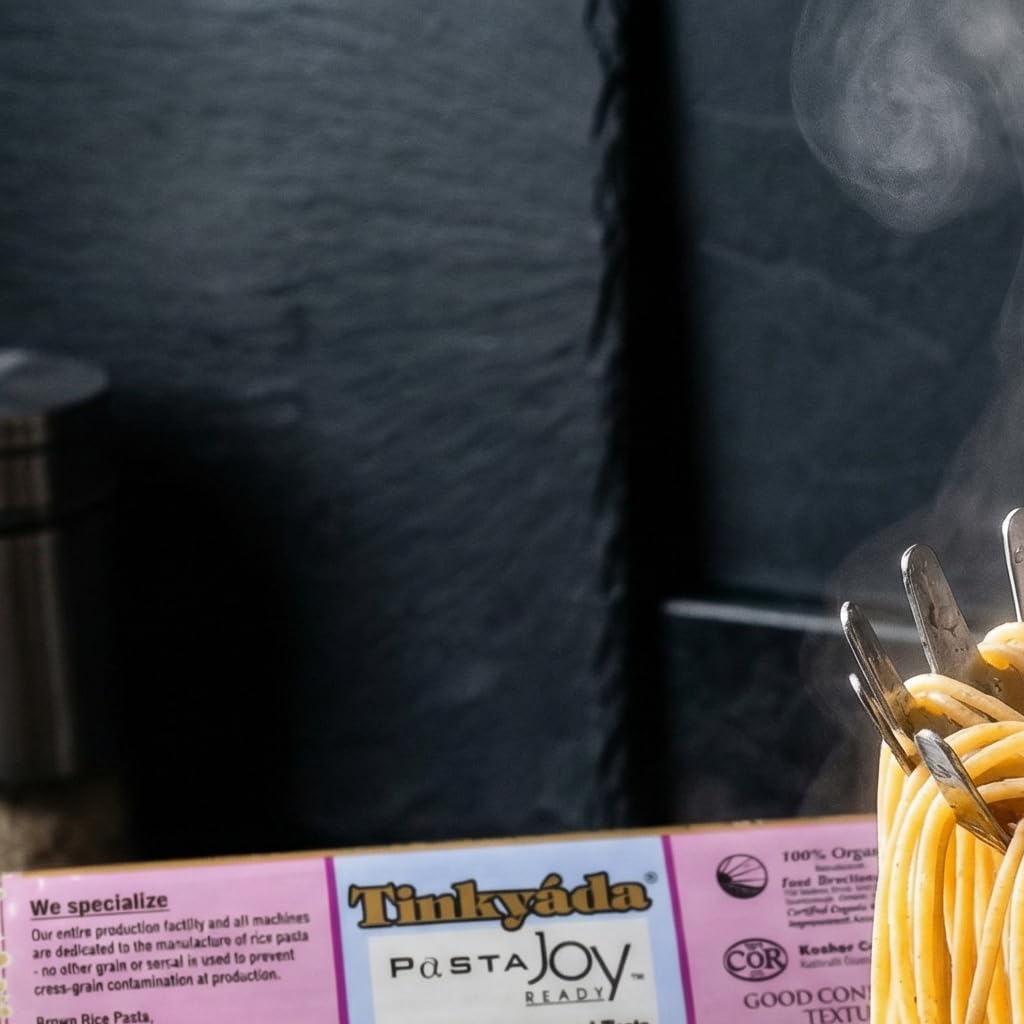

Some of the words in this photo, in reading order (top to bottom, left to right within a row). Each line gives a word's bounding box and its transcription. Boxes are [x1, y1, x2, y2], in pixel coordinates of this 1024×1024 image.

[783, 848, 827, 862] 100%
[30, 899, 61, 916] We
[67, 892, 168, 917] specialize
[349, 871, 652, 931] Tinkyáda
[31, 928, 53, 941] Our
[56, 925, 91, 939] entire
[96, 920, 160, 940] production
[208, 916, 230, 929] and
[234, 915, 249, 928] all
[253, 912, 310, 926] machines
[32, 948, 52, 959] are
[55, 941, 114, 958] dedicated
[119, 942, 130, 953] to
[133, 940, 152, 953] the
[235, 933, 247, 946] of
[251, 931, 272, 945] rice
[42, 966, 57, 977] no
[60, 962, 92, 975] other
[96, 959, 127, 976] grain
[130, 960, 142, 971] or
[202, 952, 230, 966] used
[234, 951, 245, 964] to
[249, 948, 295, 965] prevent
[107, 973, 193, 991] contamination
[197, 972, 208, 985] at
[525, 986, 604, 1005] READY
[744, 989, 812, 1009] GOOD
[817, 985, 871, 1004] CON
